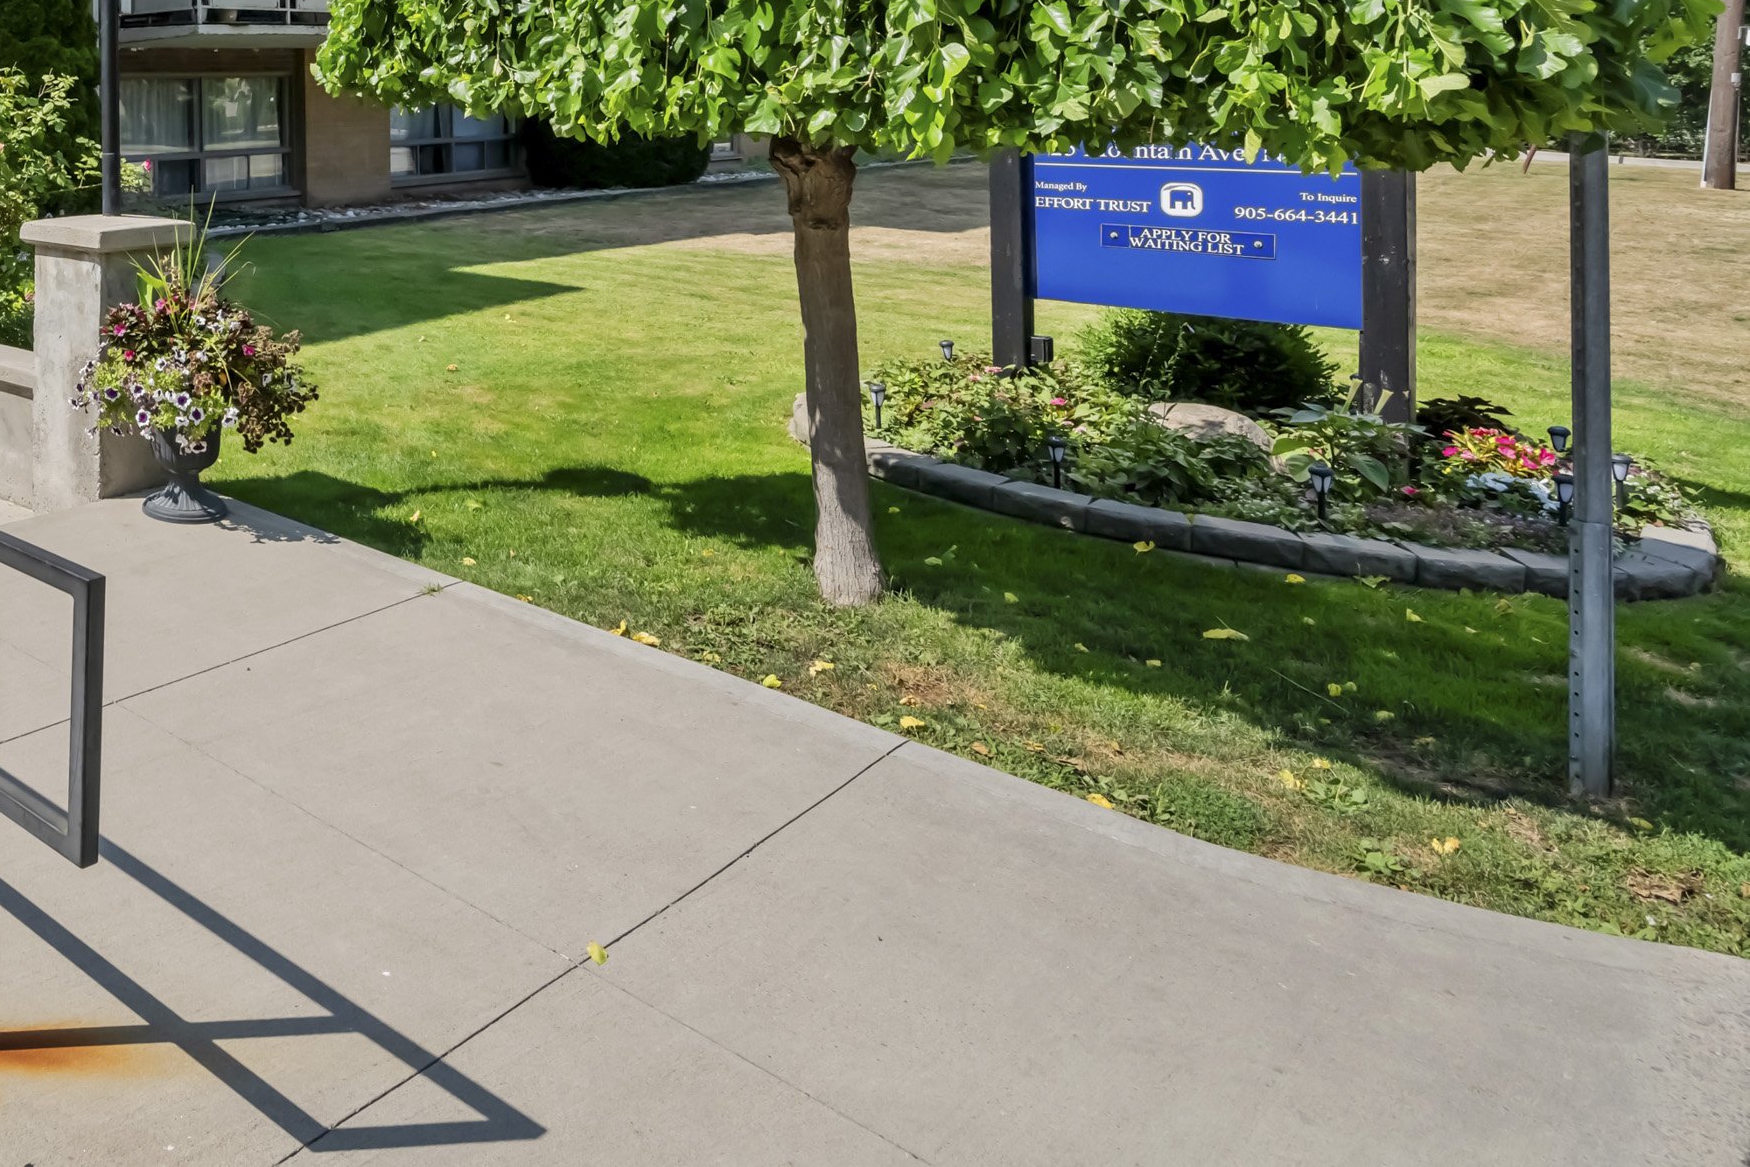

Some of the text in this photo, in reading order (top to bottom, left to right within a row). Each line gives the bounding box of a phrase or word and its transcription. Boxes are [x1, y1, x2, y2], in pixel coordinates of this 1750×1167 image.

[1035, 181, 1088, 193] Managed By
[1035, 196, 1152, 213] EFFORT TRUST
[1299, 192, 1357, 204] To Inquire
[1234, 206, 1358, 225] 905-664-3441
[1140, 228, 1231, 244] APPLY FOR
[1129, 237, 1244, 255] WAITING LIST
